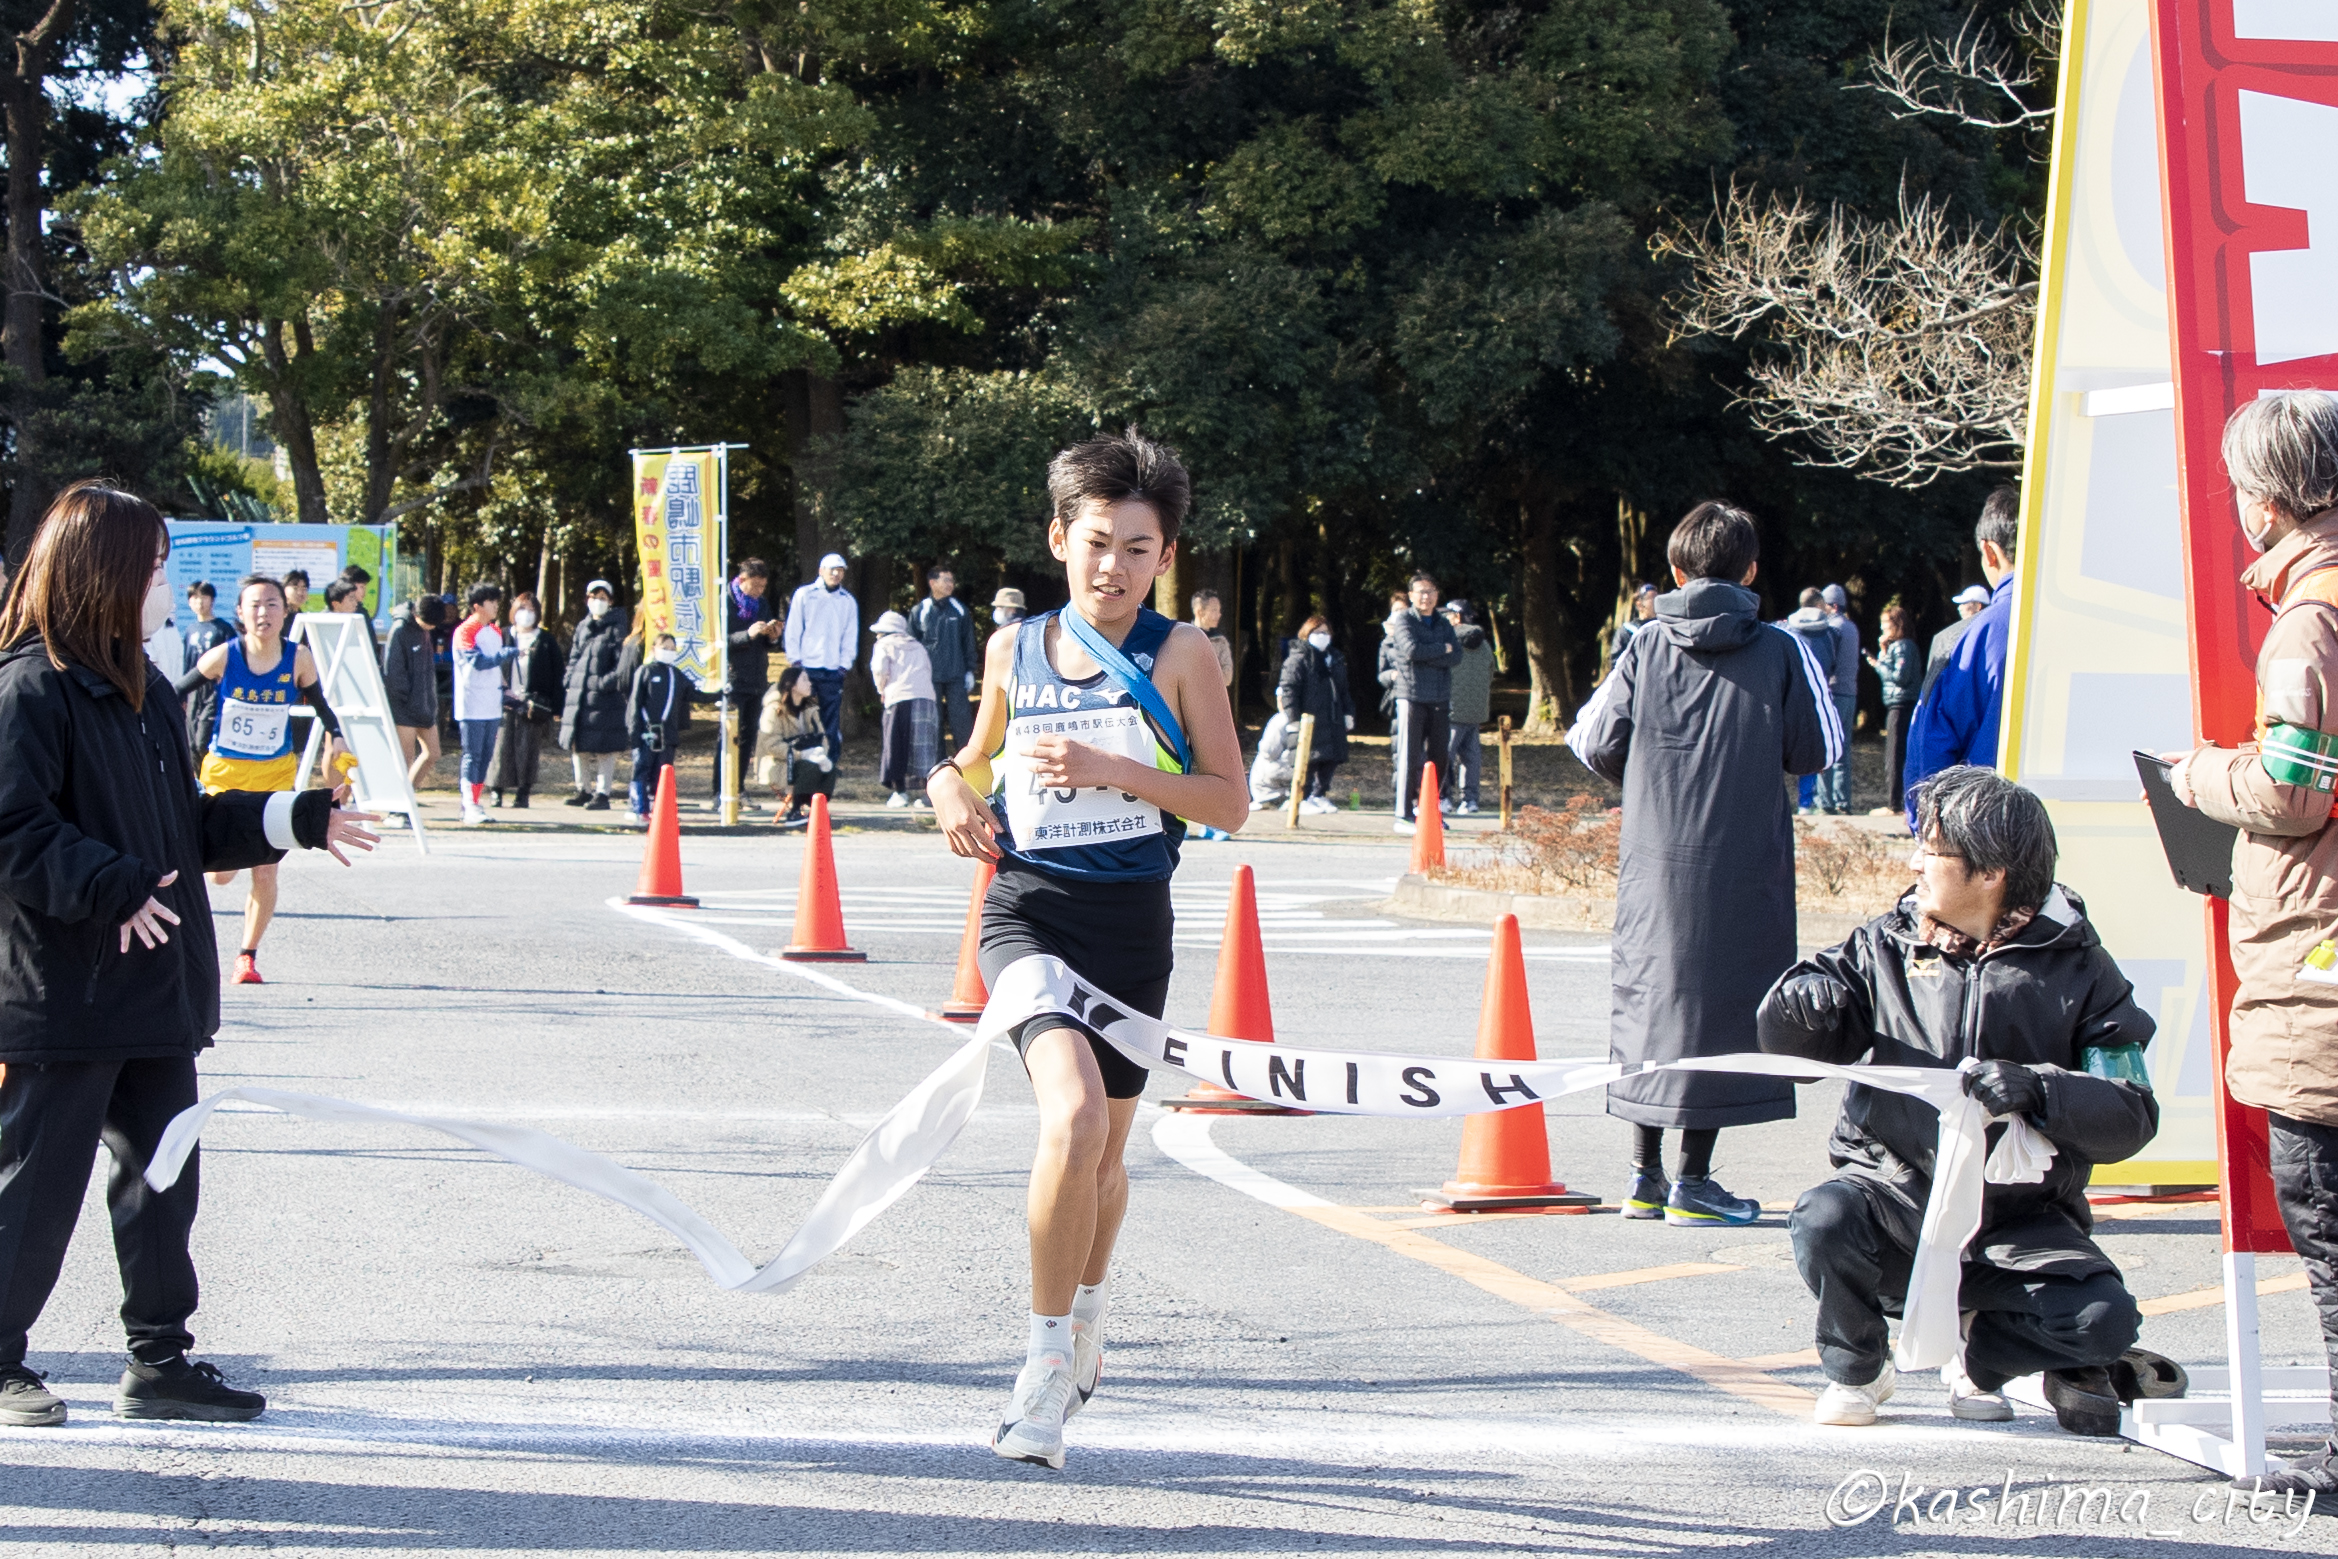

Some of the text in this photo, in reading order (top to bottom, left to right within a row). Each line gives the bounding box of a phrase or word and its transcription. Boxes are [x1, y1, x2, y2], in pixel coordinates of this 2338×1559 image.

[1015, 683, 1082, 710] HAC
[1034, 814, 1147, 841] 東洋計測株式会社
